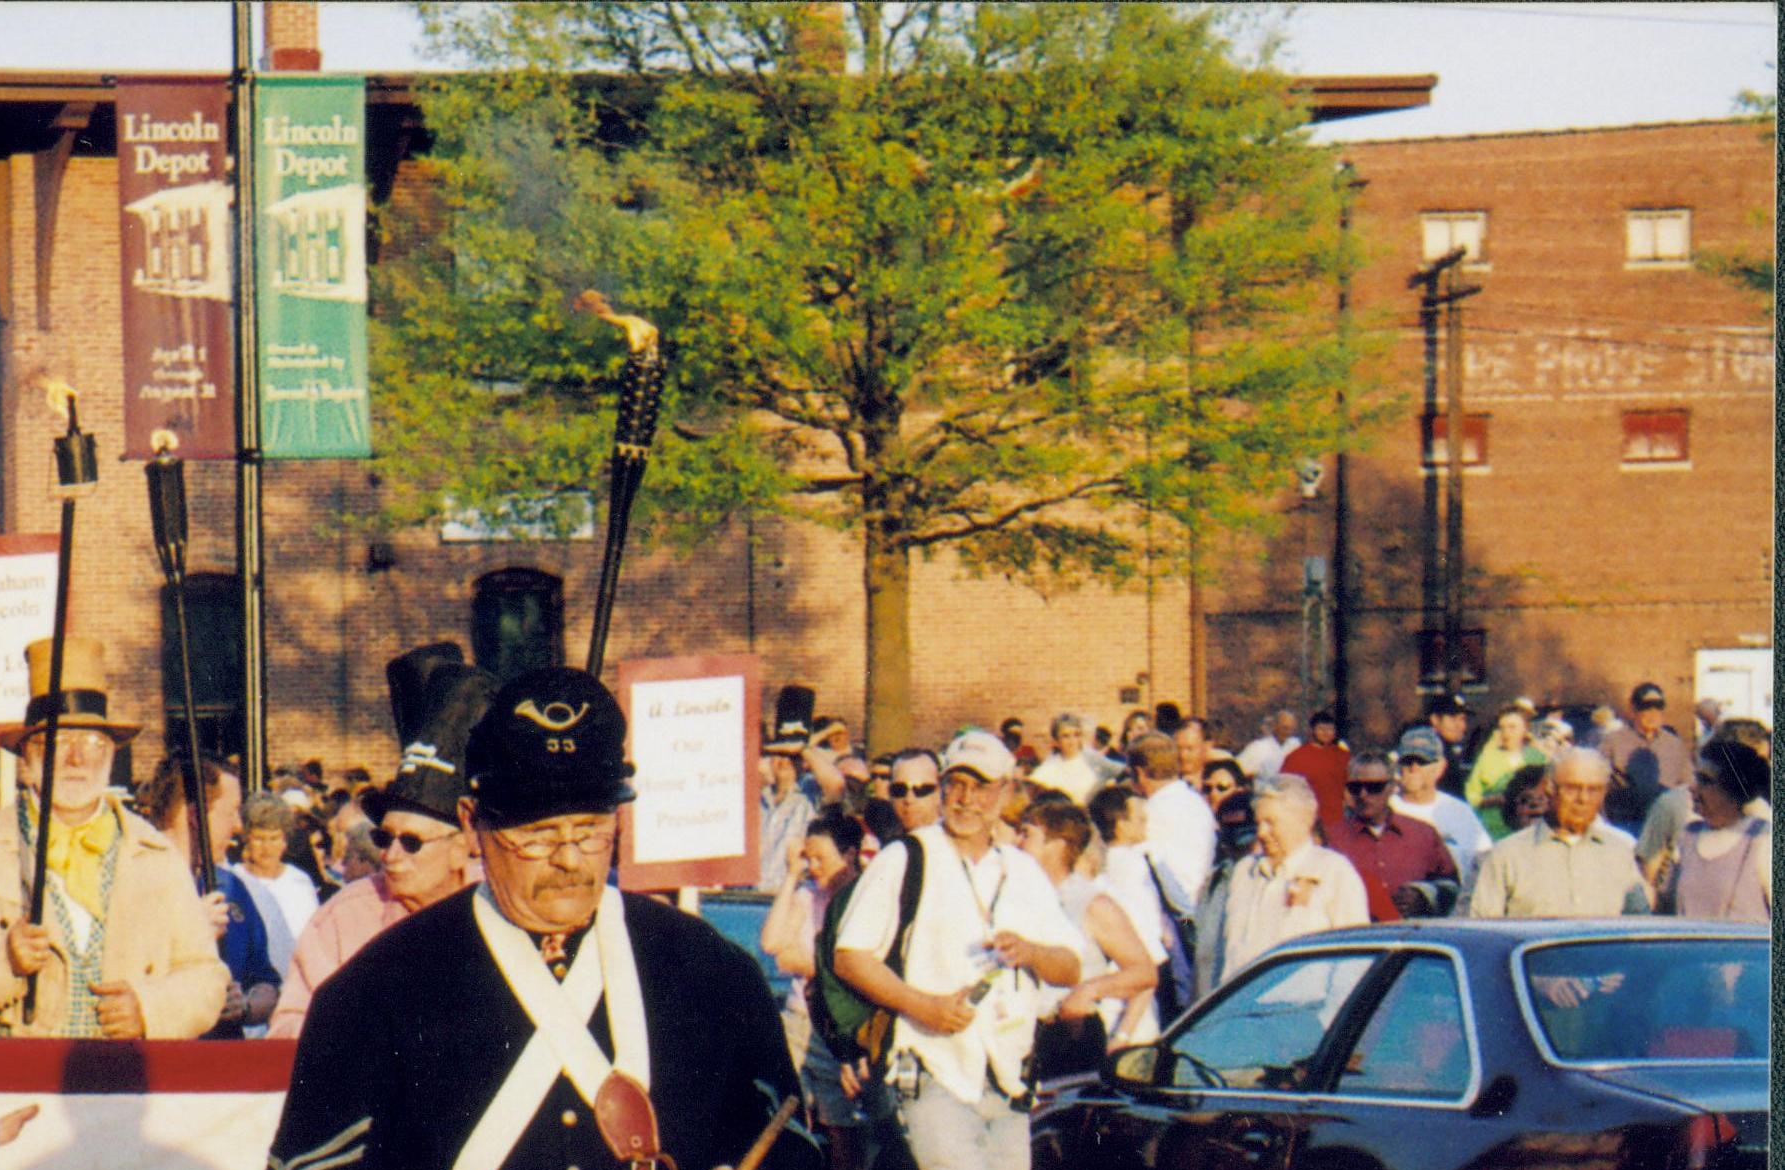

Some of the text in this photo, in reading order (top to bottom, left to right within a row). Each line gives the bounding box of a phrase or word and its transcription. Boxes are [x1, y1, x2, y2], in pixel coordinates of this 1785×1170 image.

[123, 112, 220, 143] Lincoln
[263, 115, 358, 144] Lincoln
[135, 146, 211, 182] Depot
[275, 149, 349, 184] Depot
[672, 696, 732, 718] Lincoln
[655, 808, 730, 829] President
